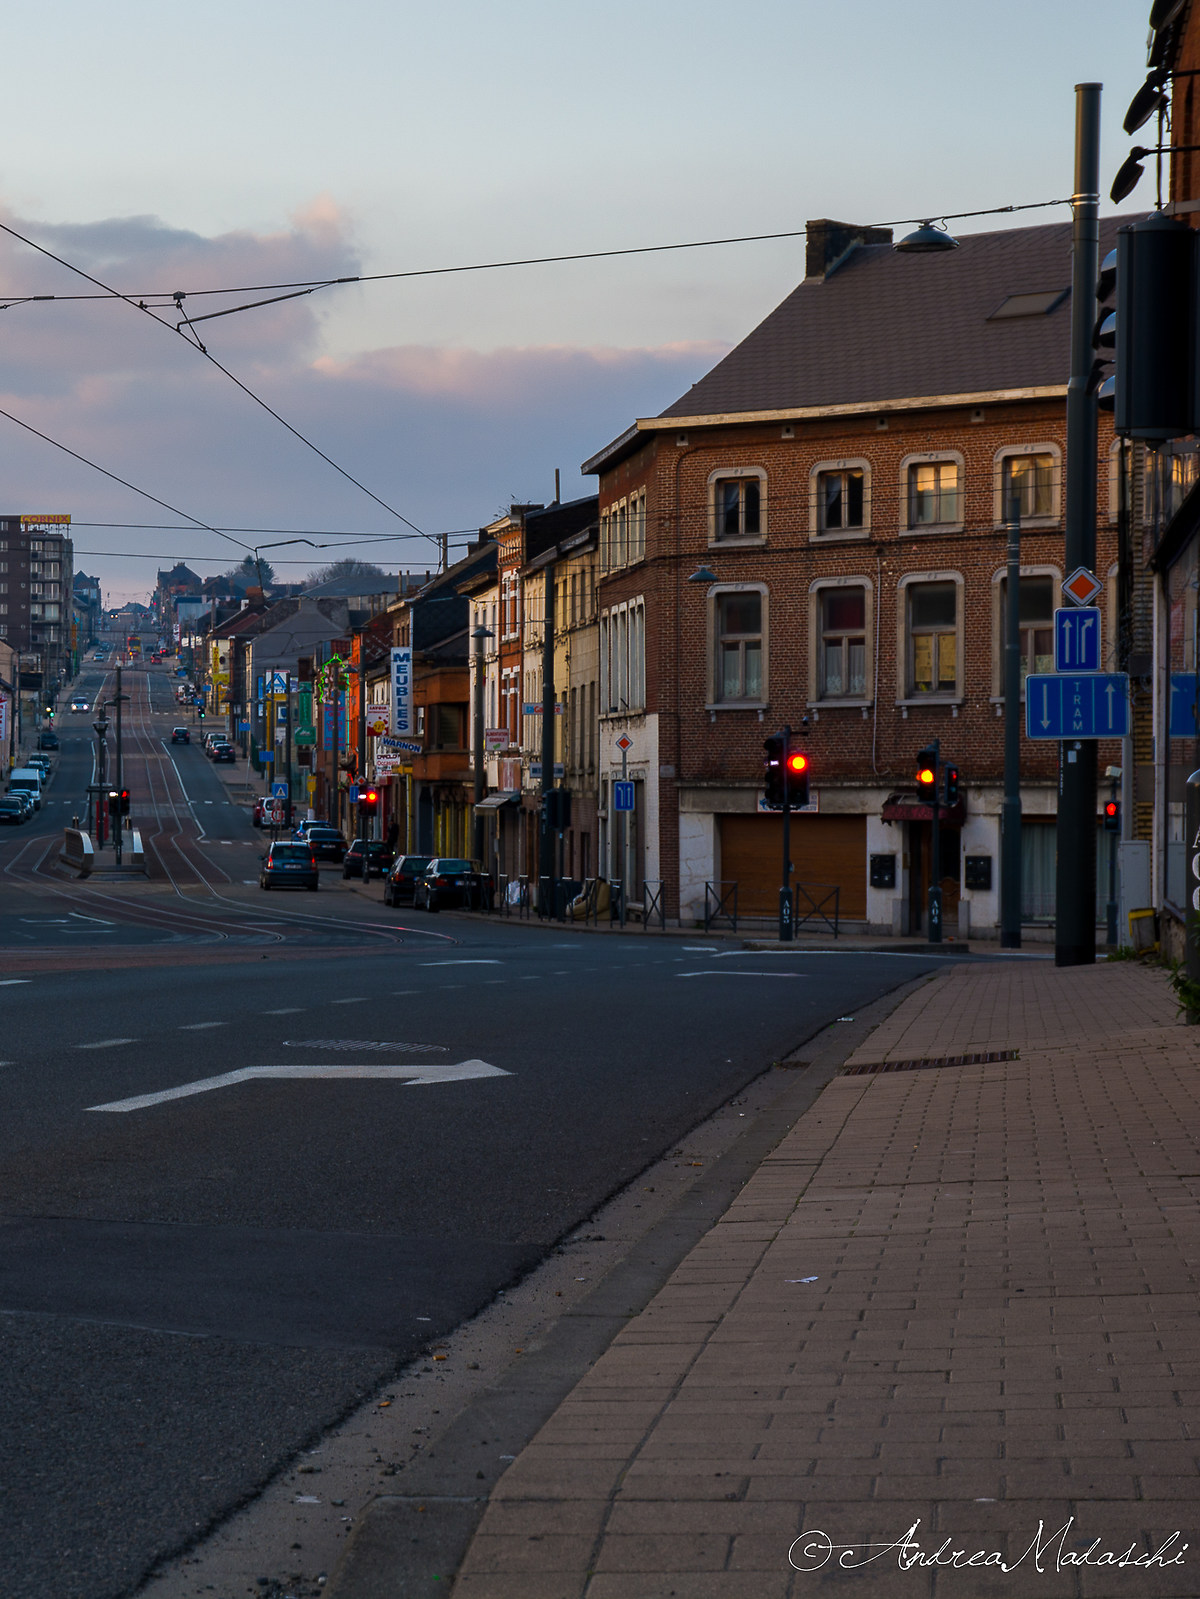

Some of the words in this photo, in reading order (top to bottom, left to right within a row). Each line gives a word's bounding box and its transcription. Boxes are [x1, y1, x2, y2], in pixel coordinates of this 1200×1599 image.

[22, 515, 69, 523] CORNIX
[393, 652, 411, 731] MEUBLES
[1072, 681, 1084, 732] TRAM
[382, 737, 422, 753] WARNON
